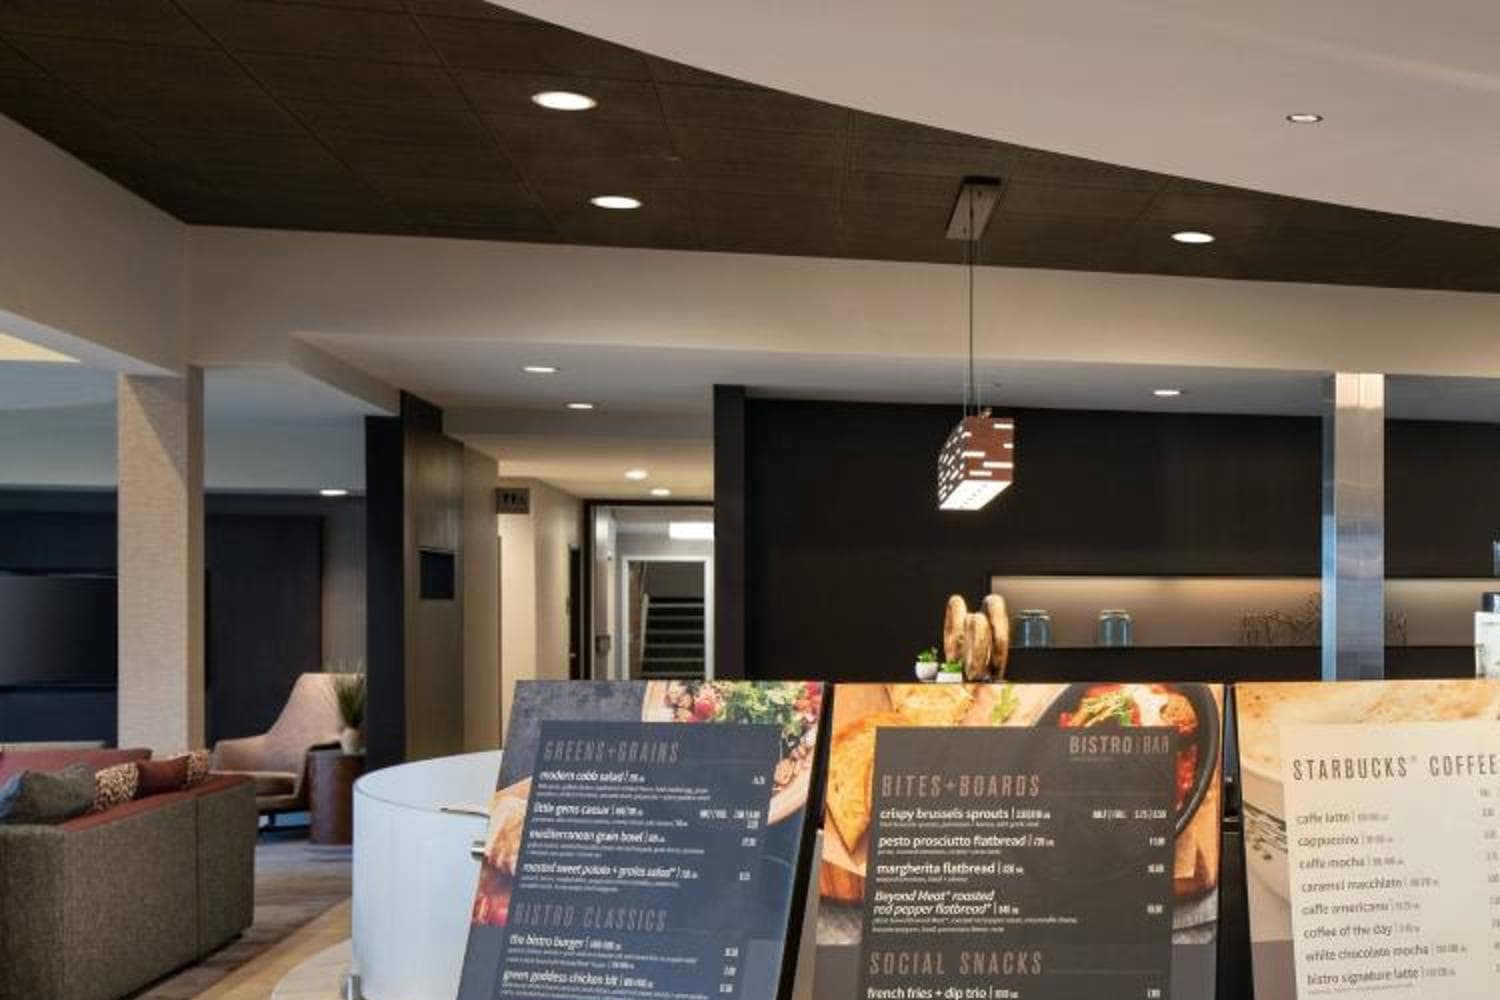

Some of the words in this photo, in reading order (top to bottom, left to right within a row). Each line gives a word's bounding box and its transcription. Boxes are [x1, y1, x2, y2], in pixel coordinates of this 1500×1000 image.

[543, 741, 681, 763] GREENS+GRAINS
[1070, 736, 1133, 753] BISTRO
[1143, 736, 1169, 753] BAR
[1429, 754, 1498, 776] COFFEE
[881, 775, 1041, 797] BITES+BOARDS
[880, 808, 914, 822] crispy
[916, 808, 964, 820] brussels
[966, 809, 1009, 823] sprouts
[879, 836, 909, 849] pesto
[912, 836, 971, 849] prosciutto
[973, 834, 1026, 847] flatbread
[877, 862, 941, 876] margherita
[942, 861, 995, 874] flatbread
[952, 890, 994, 901] roasted
[512, 904, 576, 925] BISTRO
[583, 907, 667, 930] CLASSICS
[891, 905, 933, 917] pepper
[1372, 924, 1393, 938] day
[869, 952, 945, 975] SOCIAL
[959, 952, 1042, 975] SNACKS
[867, 987, 904, 1000] french
[907, 987, 932, 1000] fries
[945, 987, 963, 1000] dip
[965, 988, 986, 999] trio
